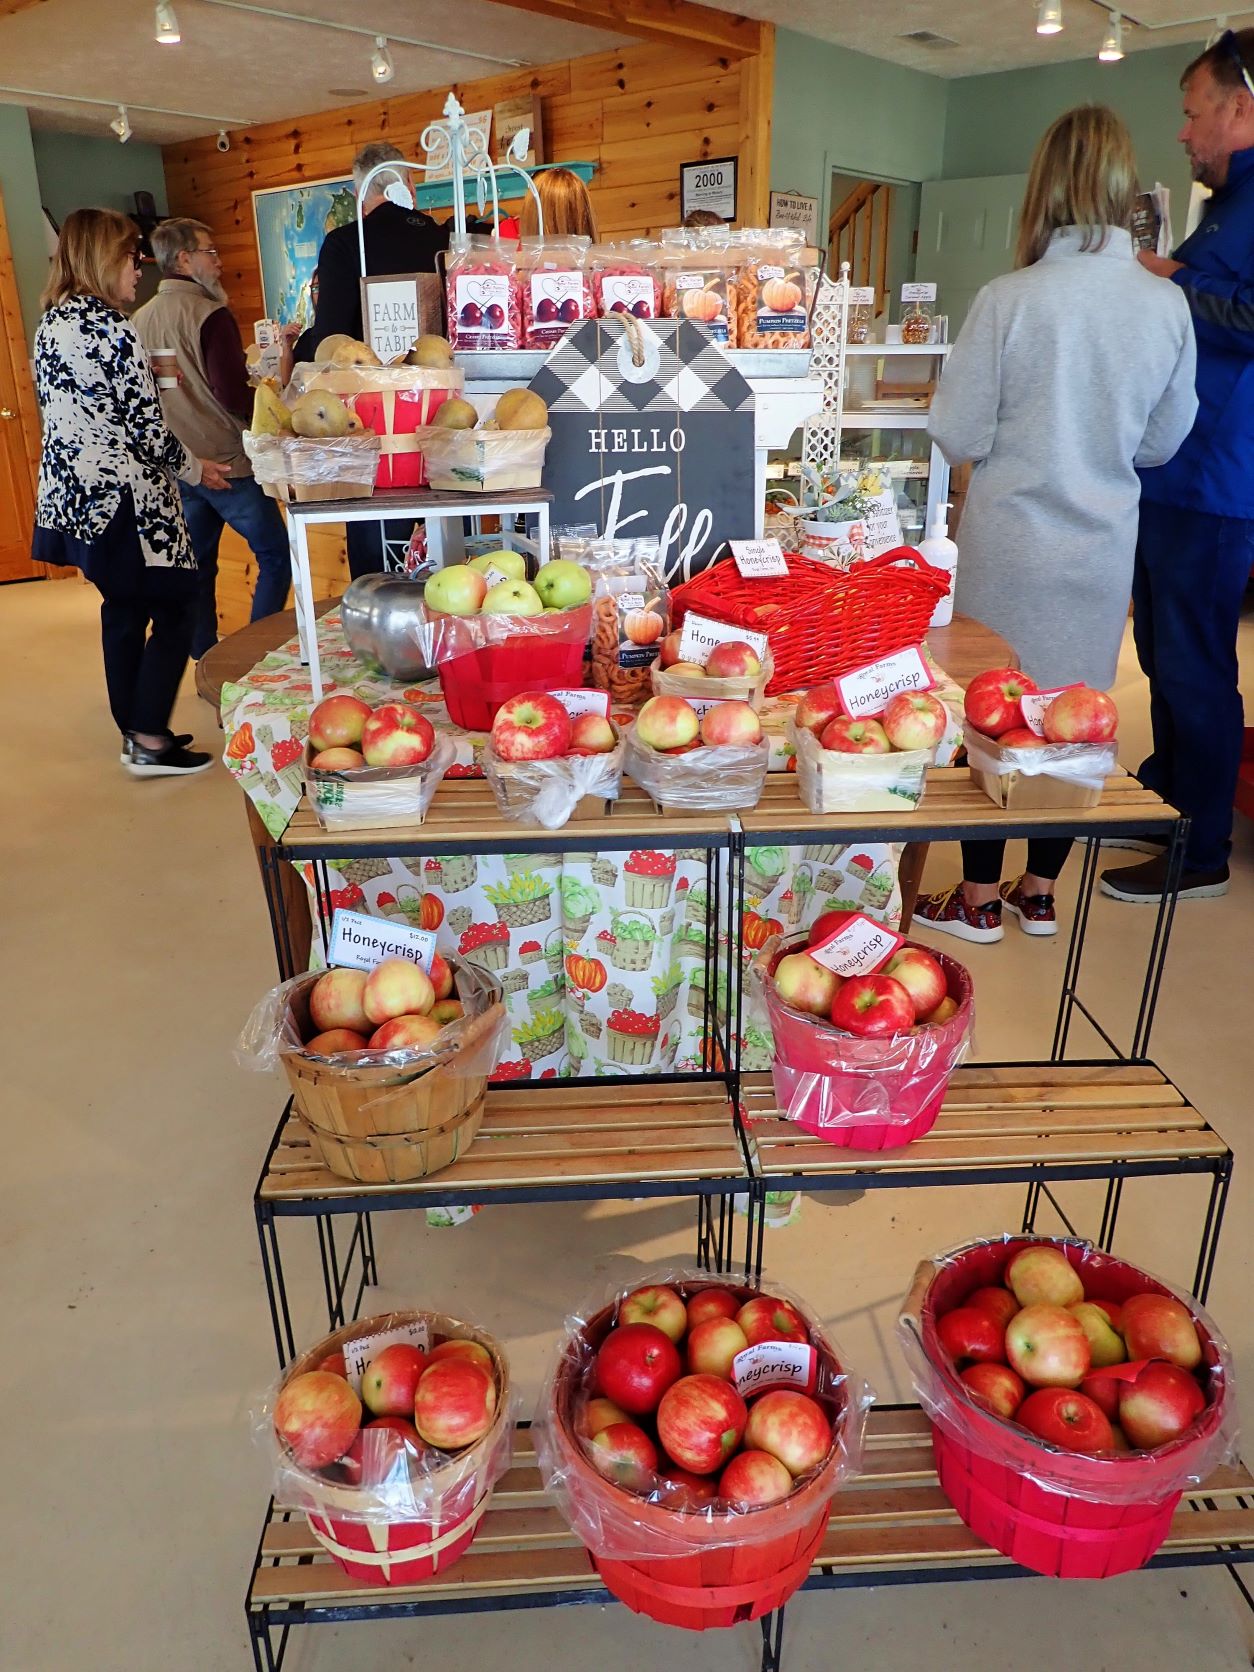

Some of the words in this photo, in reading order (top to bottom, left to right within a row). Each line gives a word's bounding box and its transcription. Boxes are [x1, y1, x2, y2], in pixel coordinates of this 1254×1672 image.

[695, 171, 723, 188] 2000
[373, 302, 416, 322] FARM
[391, 323, 398, 333] to
[588, 428, 686, 453] HELLO
[574, 465, 726, 584] Fll
[740, 555, 781, 567] Honeycrisp
[849, 672, 920, 709] Honeycrisp
[342, 927, 423, 965] Honeycrisp
[409, 932, 429, 943] $12.00
[831, 934, 884, 973] Honeycrisp
[736, 1360, 802, 1386] neycrisp
